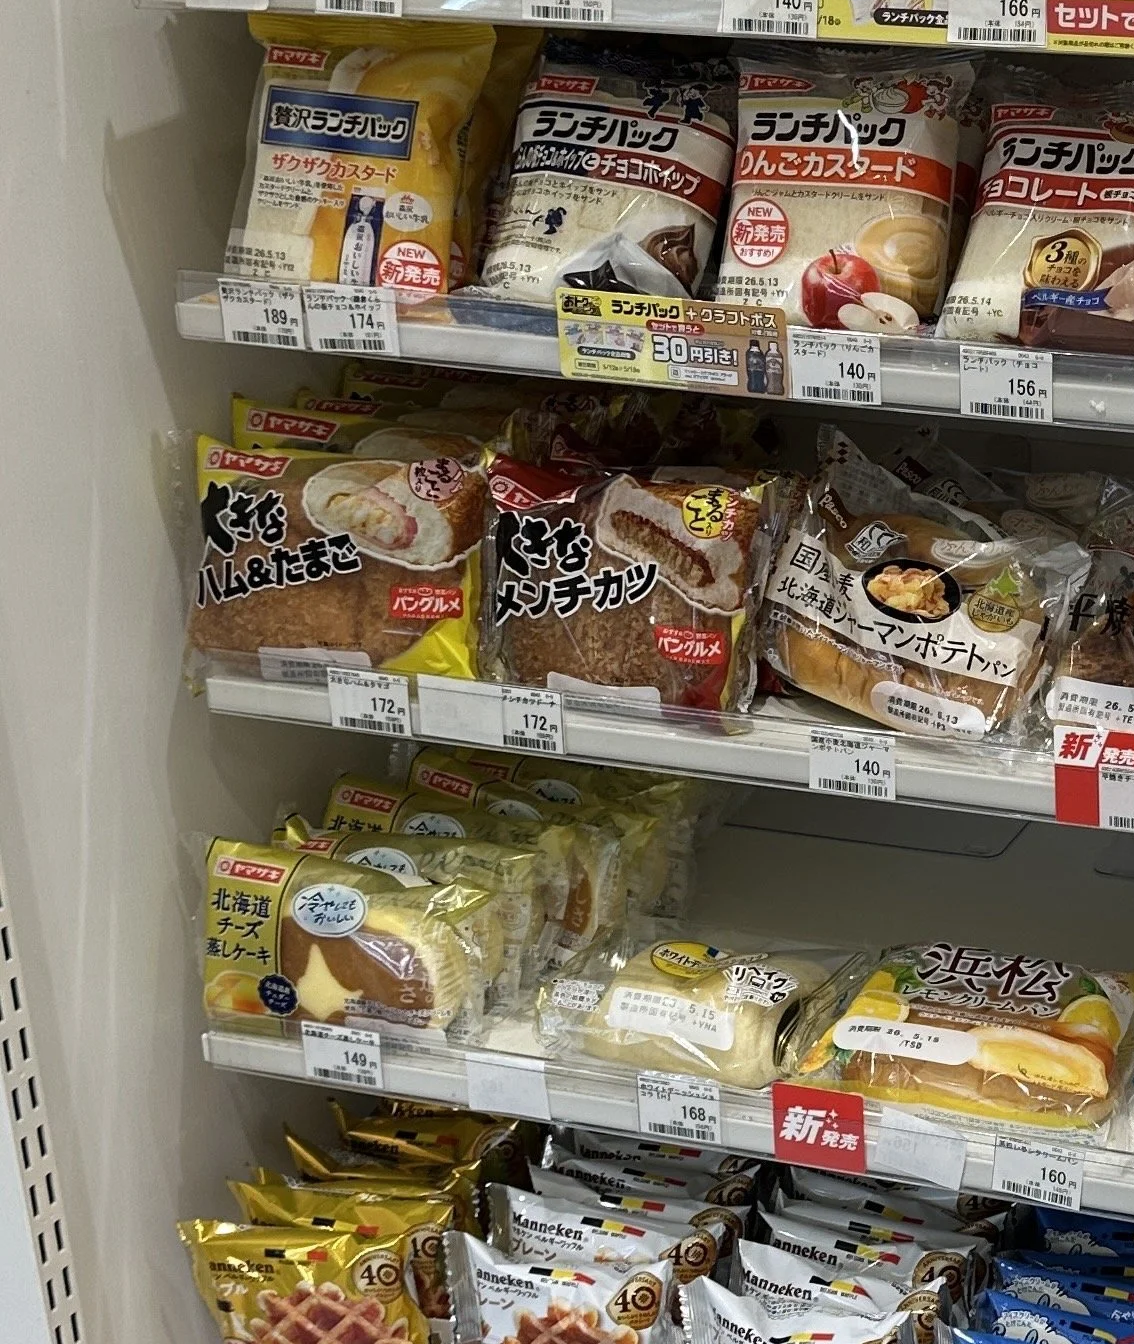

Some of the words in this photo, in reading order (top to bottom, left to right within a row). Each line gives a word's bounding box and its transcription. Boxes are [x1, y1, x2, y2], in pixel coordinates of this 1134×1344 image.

[273, 109, 407, 140] 贅沢ランチパック
[533, 111, 678, 151] ランチパック
[751, 113, 905, 145] ランチパック
[271, 153, 397, 183] ザクザクカスタード
[599, 156, 701, 195] チョコホイップ
[741, 149, 915, 180] りんごカスタード
[1045, 239, 1085, 267] 3種の
[383, 261, 441, 285] 新発売
[1039, 275, 1081, 289] 味わえる
[1046, 262, 1083, 277] チョコを
[1032, 292, 1101, 307] ベルギー産チョコ
[349, 313, 385, 331] 174円
[1008, 379, 1048, 398] 156円
[203, 482, 288, 554] 大きな
[198, 533, 361, 607] ハム&たまご
[393, 596, 460, 614] パングルメ
[497, 563, 657, 622] メンチカツ
[778, 577, 1016, 679] 北海道ジャーマンポテトパン
[232, 861, 285, 882] ヤマザキ
[213, 888, 271, 919] 北海道
[301, 895, 356, 914] 冷やしても
[314, 912, 354, 925] おいしい
[217, 918, 261, 939] チーズ
[207, 940, 271, 962] 蒸しケーキ
[918, 943, 1069, 1003] 浜松
[901, 985, 1060, 1017] レモンクリームパン
[780, 1107, 857, 1152] 新発売
